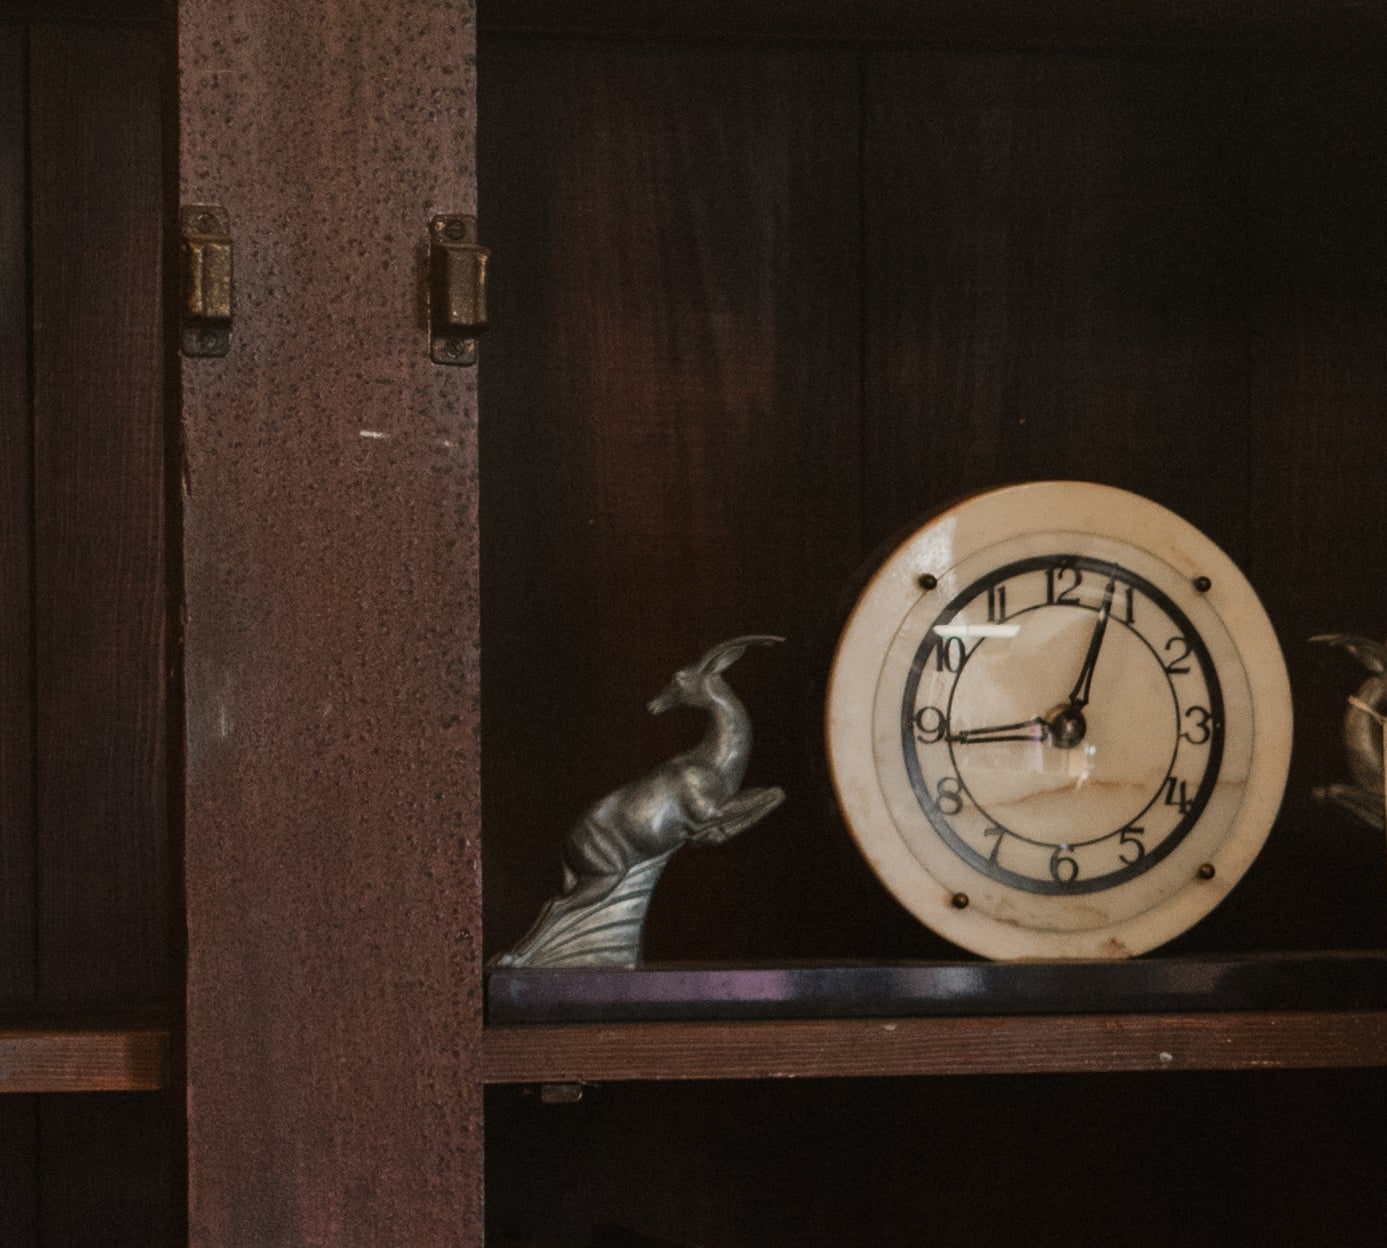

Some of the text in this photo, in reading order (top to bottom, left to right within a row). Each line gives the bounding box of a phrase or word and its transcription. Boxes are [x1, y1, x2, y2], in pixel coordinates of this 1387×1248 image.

[987, 586, 1007, 623] 11
[1045, 566, 1083, 605] 12
[1123, 587, 1136, 624] 1
[933, 636, 967, 674] 10
[1165, 637, 1192, 674] 2
[914, 706, 948, 744] 9
[1180, 705, 1213, 744] 3
[935, 776, 964, 816] 8
[1164, 776, 1195, 814] 4
[983, 827, 1008, 865] 7
[1118, 825, 1145, 864] 5
[1050, 846, 1079, 883] 6
